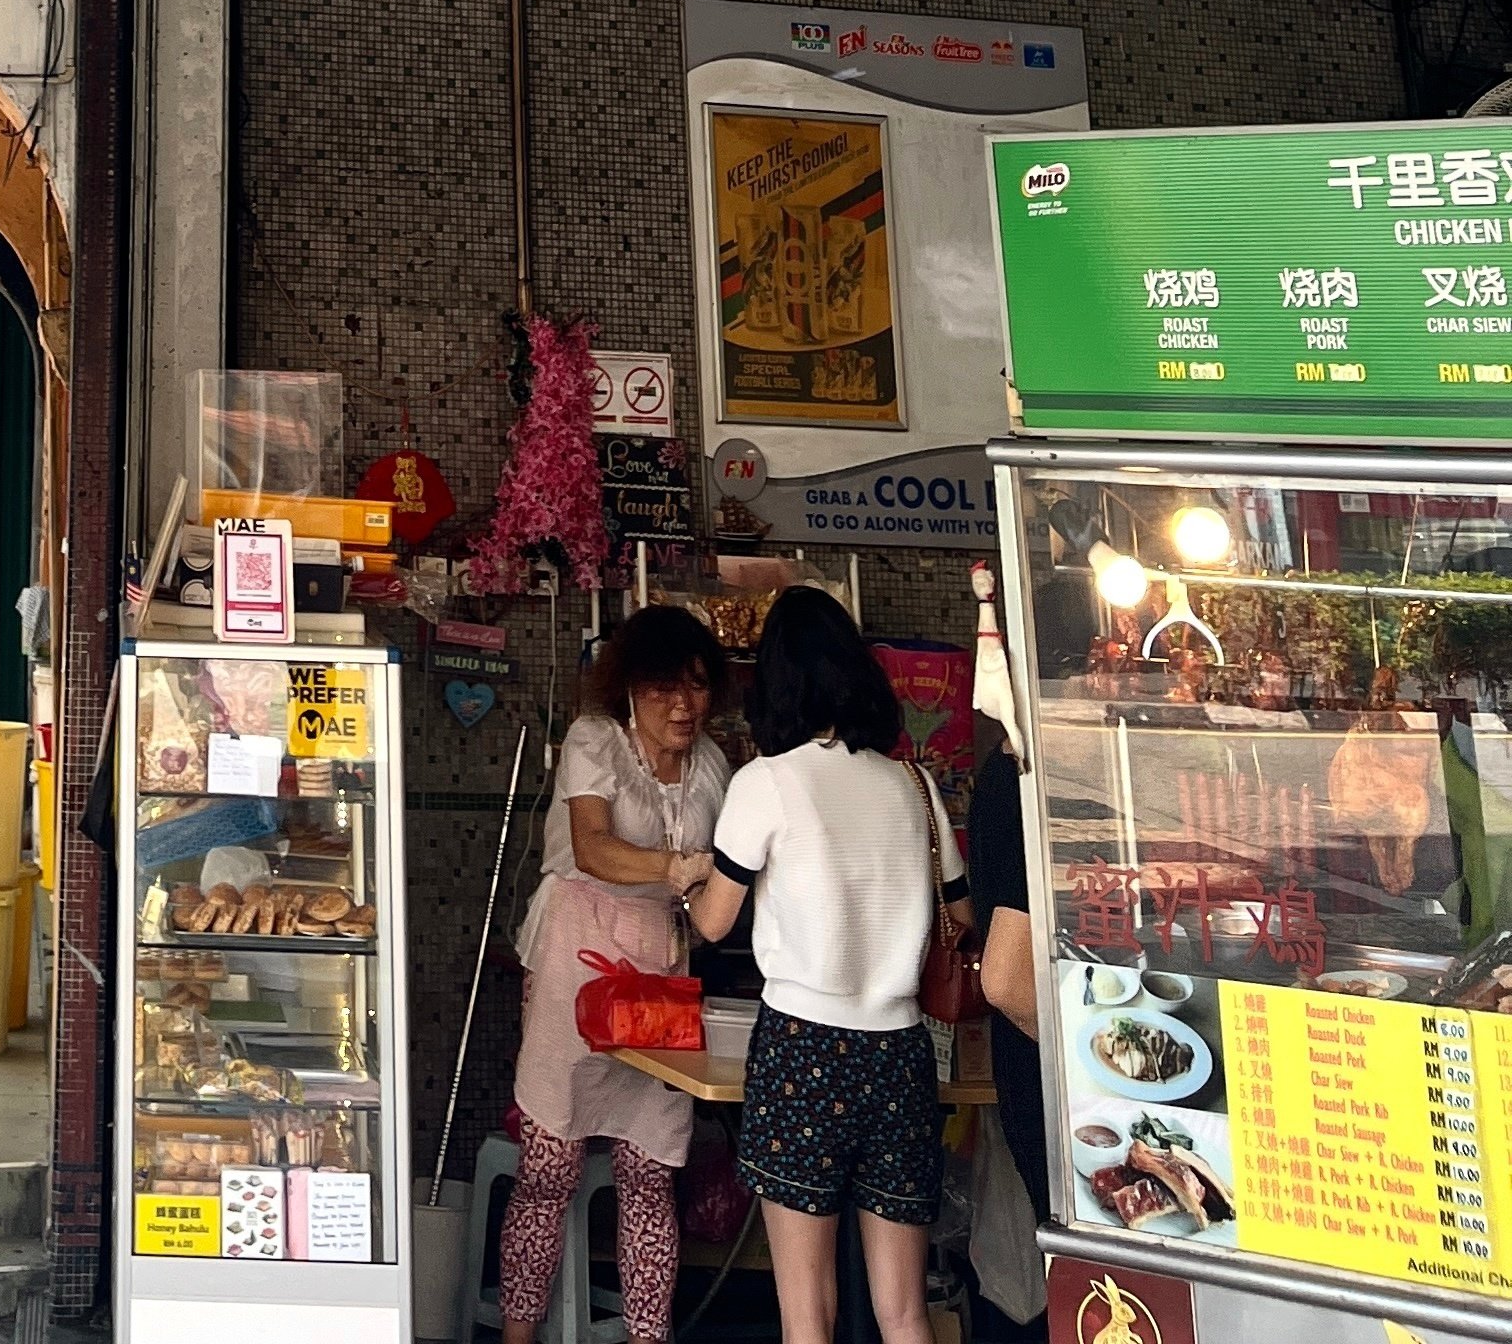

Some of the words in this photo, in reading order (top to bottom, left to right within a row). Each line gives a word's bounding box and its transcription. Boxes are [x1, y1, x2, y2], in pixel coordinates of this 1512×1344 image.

[797, 23, 825, 41] 100
[797, 41, 826, 52] PLUS
[872, 41, 925, 57] SEASONS
[801, 131, 850, 174] GOING!
[726, 154, 764, 192] KEEP
[766, 136, 794, 169] THE
[1028, 172, 1066, 190] MILO
[1327, 148, 1512, 209] 千里香
[1393, 218, 1503, 246] CHICKEN
[1143, 267, 1221, 309] 烧鸡
[1278, 267, 1360, 309] 烧肉
[1422, 265, 1509, 309] 叉烧
[1162, 317, 1210, 333] ROAST
[1299, 317, 1350, 333] ROAST
[1426, 317, 1470, 334] CHAR
[1472, 318, 1512, 334] SIEW
[1157, 334, 1219, 350] CHICKEN
[1306, 334, 1349, 350] PORK
[743, 364, 792, 376] SPECIAL
[1158, 361, 1187, 381] RM
[1295, 362, 1326, 382] RM
[1438, 363, 1471, 384] RM
[805, 489, 852, 506] GRAB
[855, 490, 869, 507] A
[873, 475, 975, 511] COOL
[617, 489, 679, 528] laugh
[805, 513, 828, 530] TO
[832, 514, 859, 531] GO
[863, 516, 924, 534] ALONG
[927, 518, 969, 535] WITH
[975, 520, 996, 536] YO
[287, 667, 327, 686] WE
[287, 686, 366, 705] PREFER
[298, 709, 357, 740] MAE
[1305, 1002, 1339, 1021] Roasted
[1342, 1007, 1376, 1025] Chicken
[1307, 1024, 1340, 1043] Roasted
[1344, 1028, 1367, 1047] Duck
[1421, 1016, 1438, 1034] RM
[1309, 1046, 1342, 1066] Roasted
[1346, 1051, 1367, 1070] Pork
[1424, 1040, 1440, 1059] RM
[1311, 1070, 1330, 1088] Char
[1334, 1073, 1354, 1091] Siew
[1425, 1062, 1442, 1080] RM
[1313, 1093, 1346, 1114] Roasted
[1350, 1098, 1371, 1118] Pork
[1374, 1102, 1389, 1120] Rib
[1427, 1086, 1445, 1106] RM
[1430, 1110, 1447, 1129] RM
[1315, 1117, 1348, 1138] Roasted
[1352, 1123, 1386, 1148] Sausage
[1432, 1135, 1449, 1155] RM
[1316, 1141, 1336, 1160] Char
[1340, 1145, 1360, 1163] Siew
[1390, 1153, 1425, 1174] Chicken
[1434, 1159, 1451, 1179] RM
[1330, 1167, 1351, 1186] Pork
[1381, 1175, 1416, 1197] Chicken
[1437, 1184, 1454, 1204] RM
[1332, 1191, 1353, 1211] Pork
[1356, 1195, 1371, 1213] Rib
[1402, 1203, 1437, 1225] Chicken
[1439, 1208, 1456, 1228] RM
[1322, 1214, 1342, 1232] Char
[1346, 1217, 1366, 1237] Siew
[1397, 1225, 1419, 1247] Pork
[1442, 1233, 1459, 1254] RM
[1407, 1257, 1485, 1285] Additional
